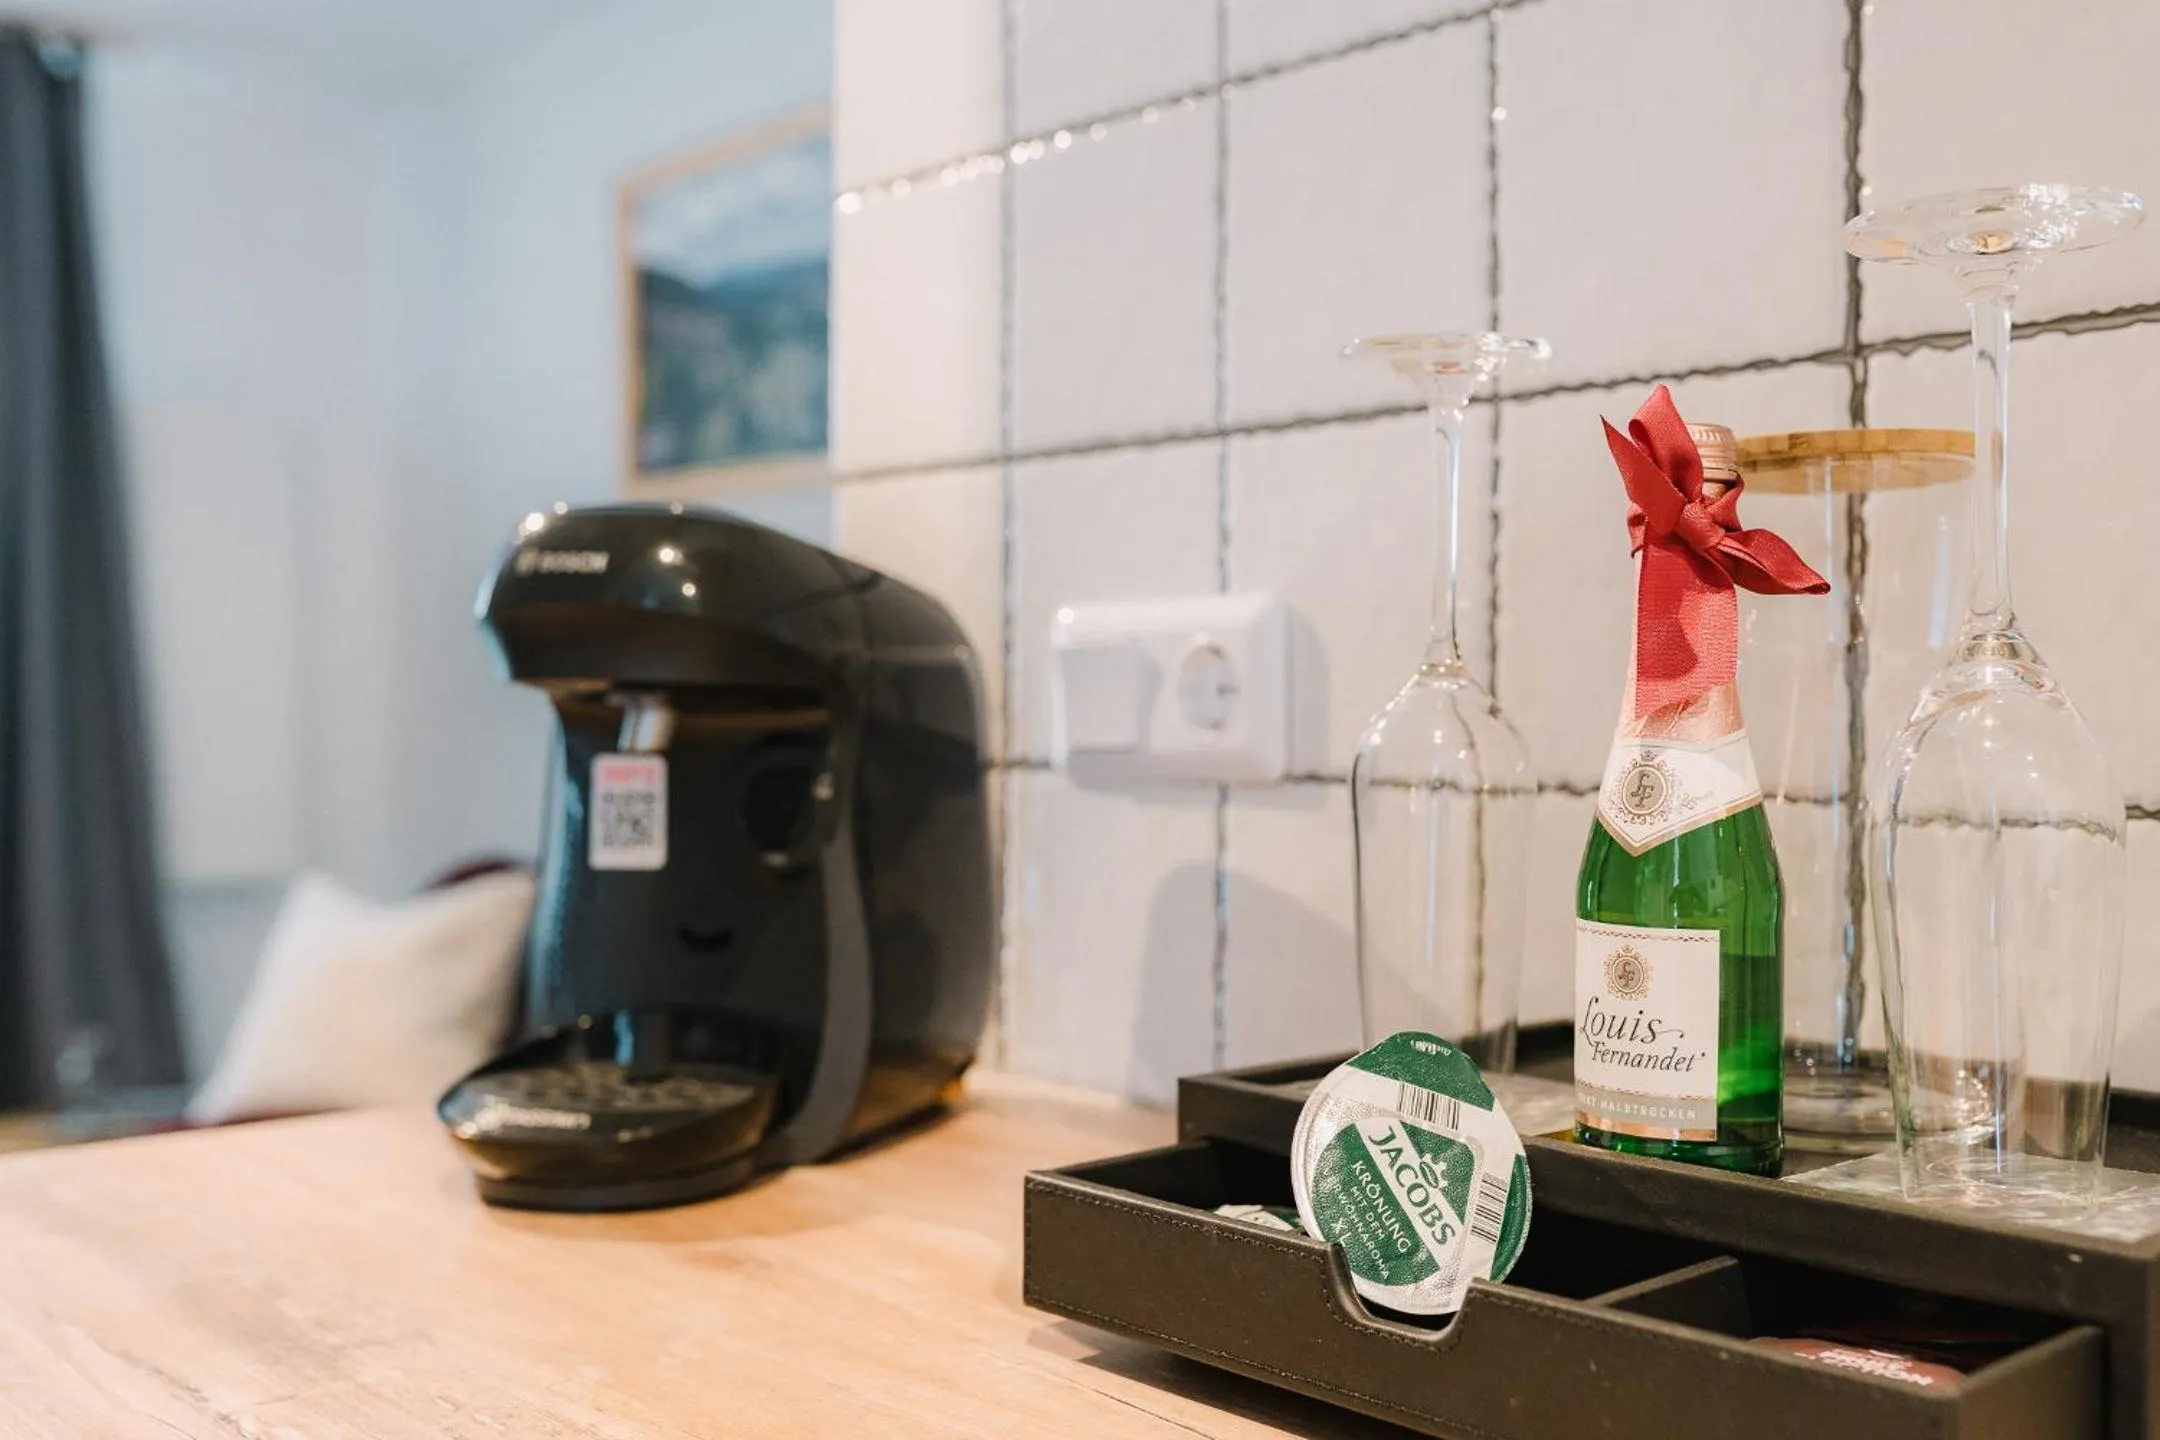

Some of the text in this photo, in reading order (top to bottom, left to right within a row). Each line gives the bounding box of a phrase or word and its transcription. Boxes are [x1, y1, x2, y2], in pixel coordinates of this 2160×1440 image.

[1580, 996, 1684, 1047] Louis
[1600, 1096, 1697, 1121] HALBTROCKEN
[1351, 1159, 1412, 1254] KRÖNUNG
[1368, 1125, 1456, 1245] JACOBS
[1329, 1216, 1351, 1249] XL
[1350, 1185, 1386, 1241] MIT DEM
